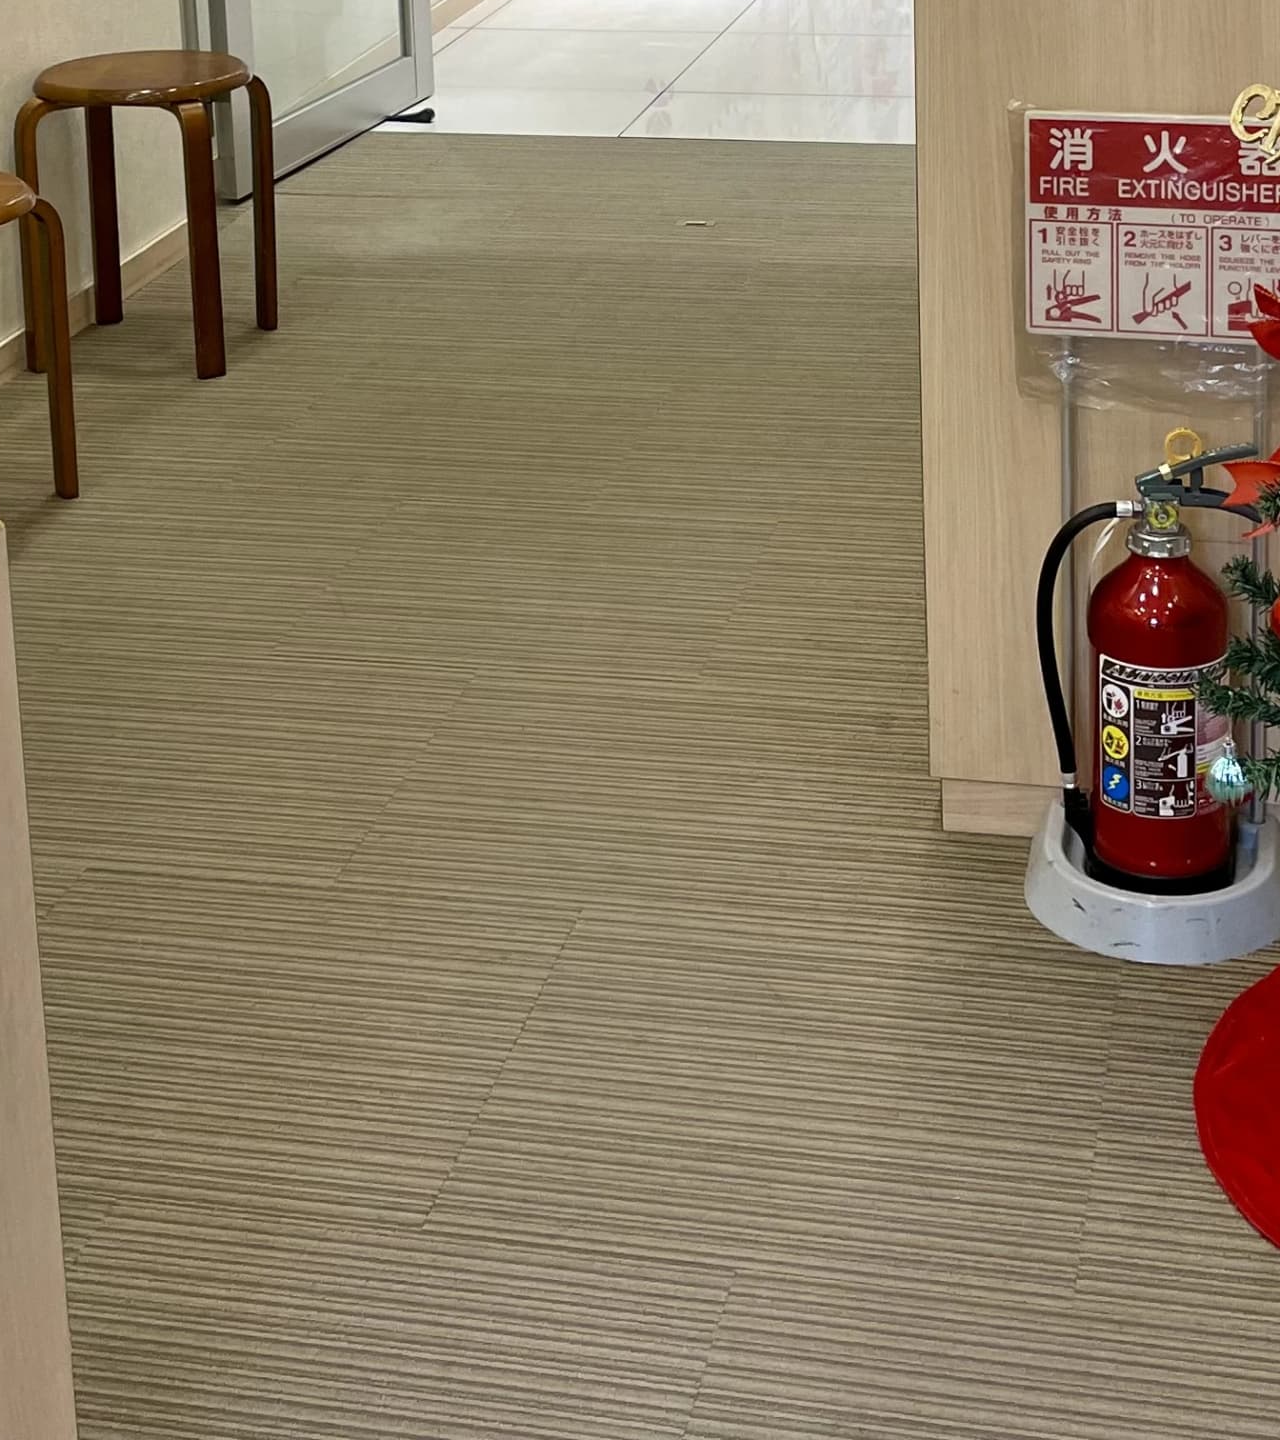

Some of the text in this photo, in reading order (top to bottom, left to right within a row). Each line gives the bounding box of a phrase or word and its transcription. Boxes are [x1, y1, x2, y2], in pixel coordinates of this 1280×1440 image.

[1038, 175, 1091, 198] FIRE
[1043, 205, 1123, 223] 使用方法
[1037, 227, 1048, 244] 1
[1123, 230, 1137, 248] 2
[1218, 234, 1233, 252] 3
